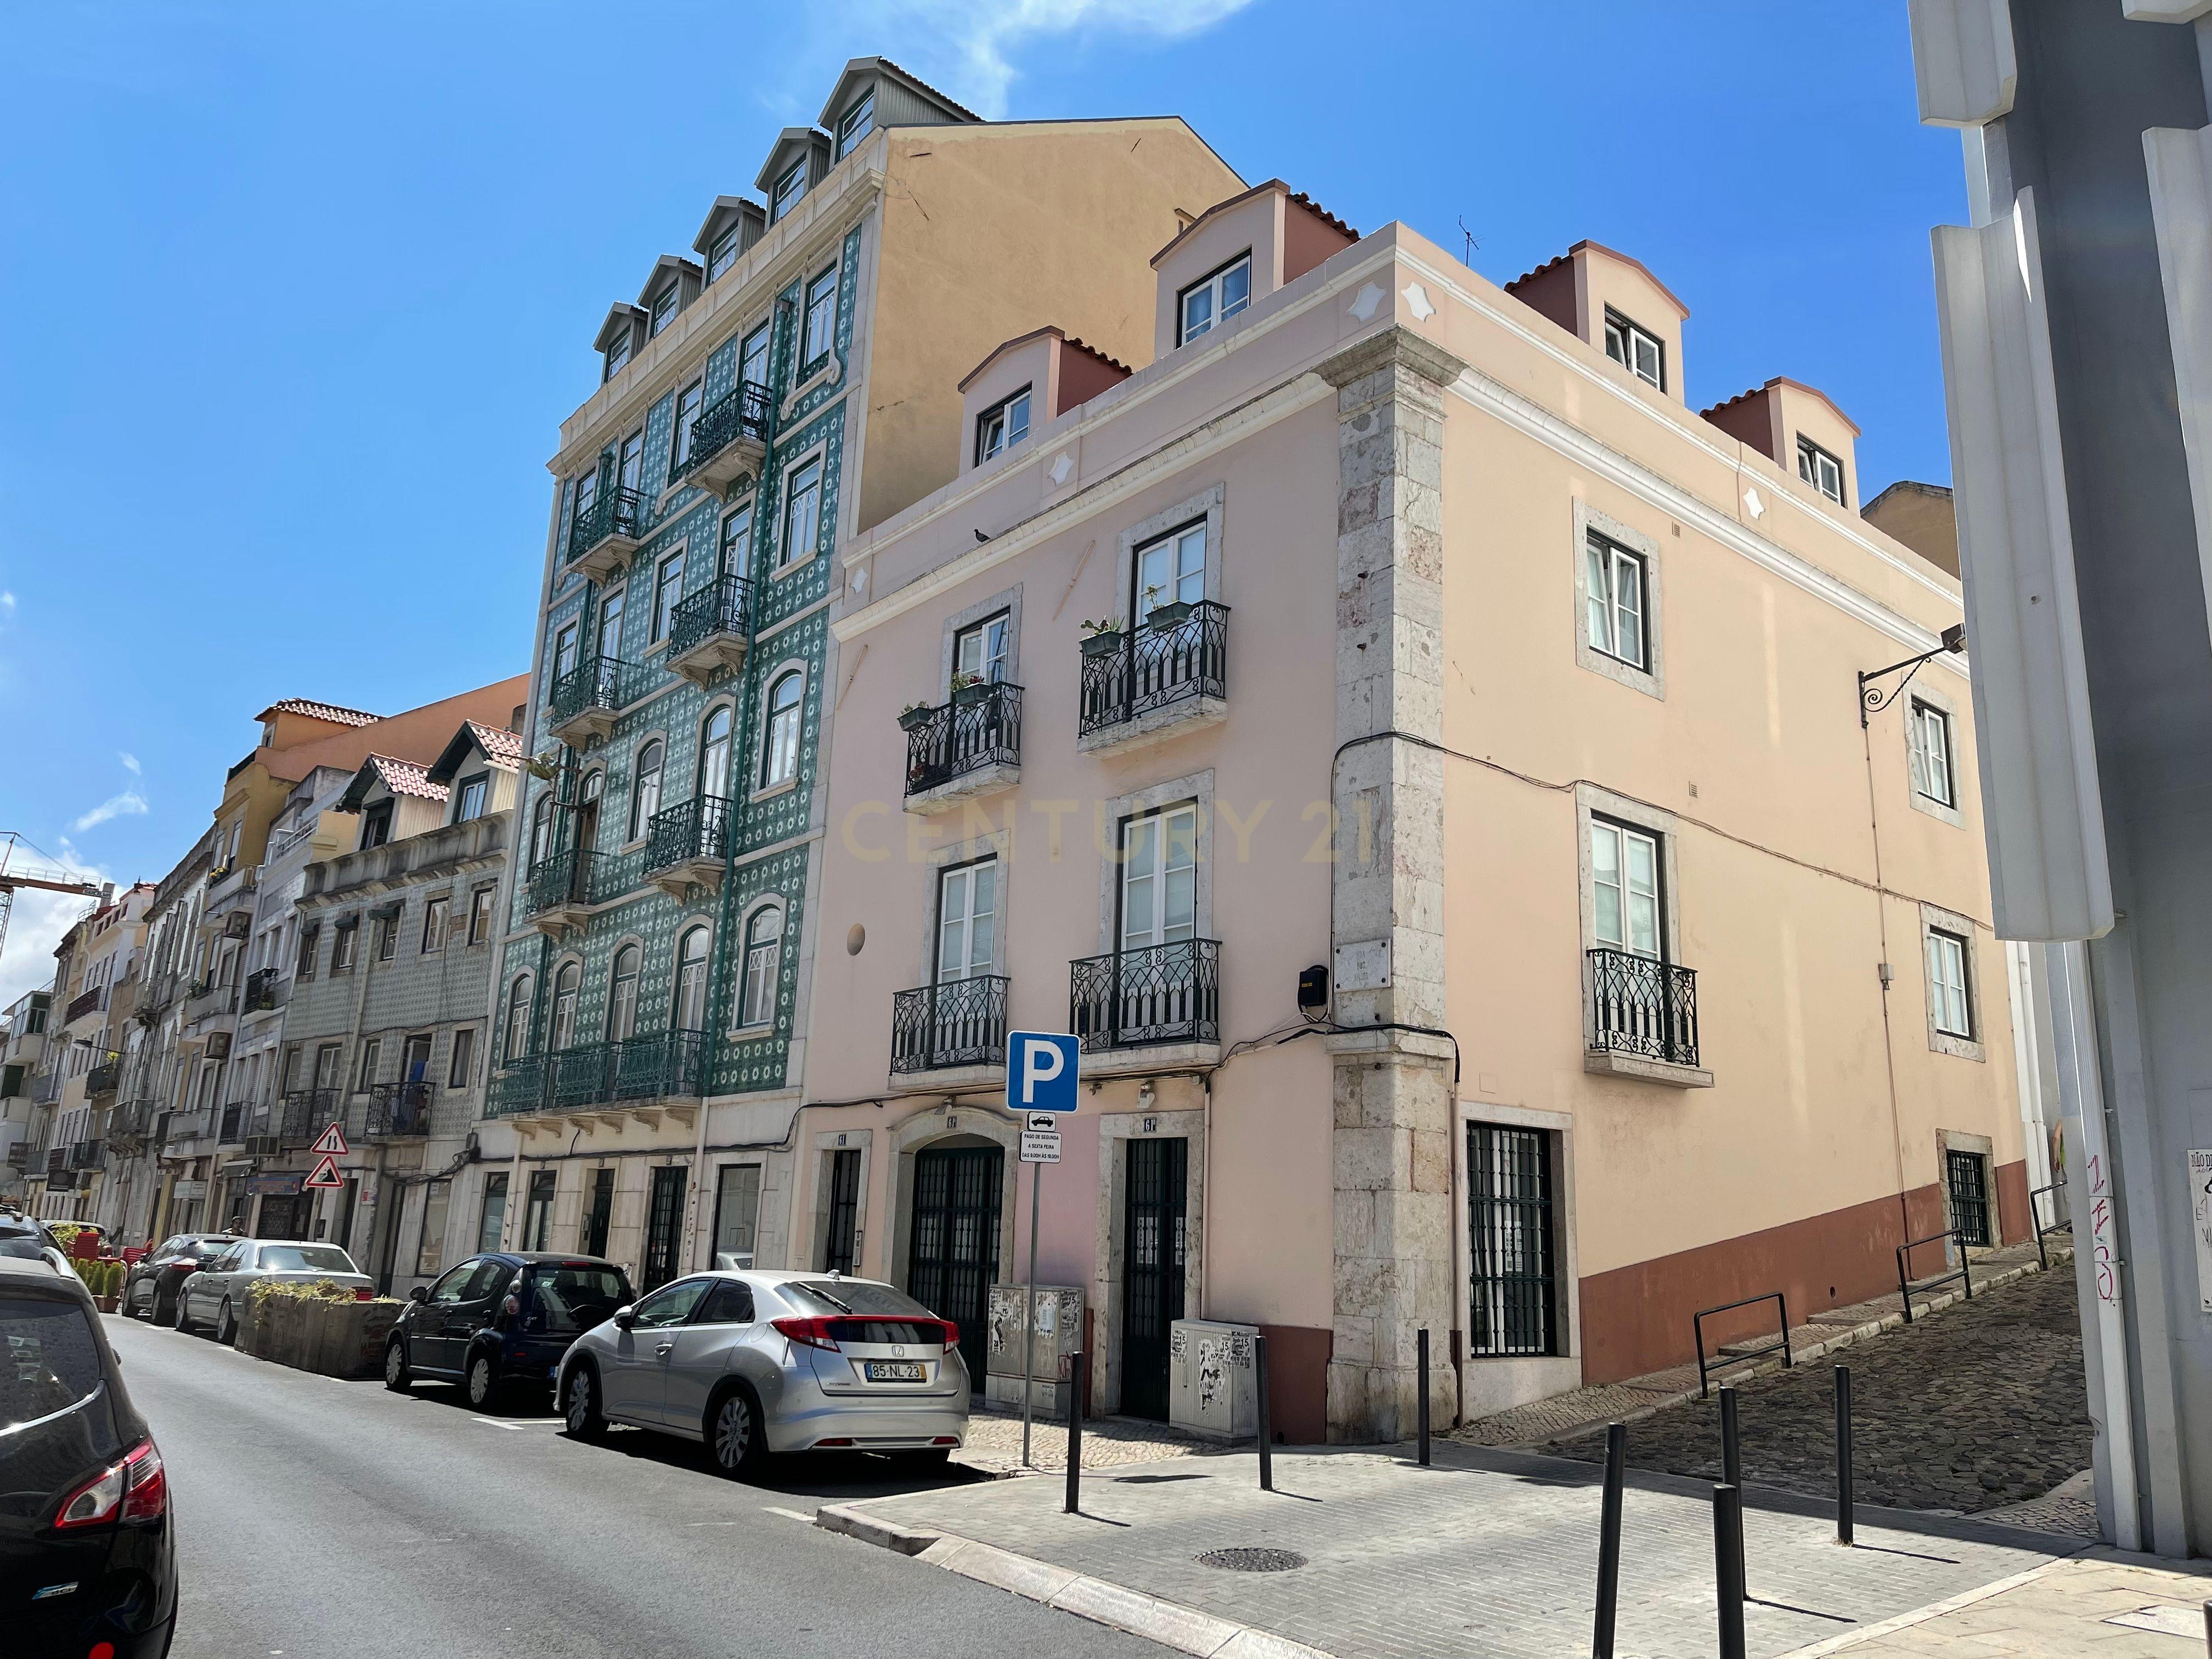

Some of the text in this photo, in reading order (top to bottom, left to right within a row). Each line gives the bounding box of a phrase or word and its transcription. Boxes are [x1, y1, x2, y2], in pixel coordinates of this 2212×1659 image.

[1023, 1039, 1064, 1103] P
[1179, 1336, 1186, 1345] 15
[1241, 1338, 1249, 1347] 15
[1222, 1341, 1229, 1350] 15
